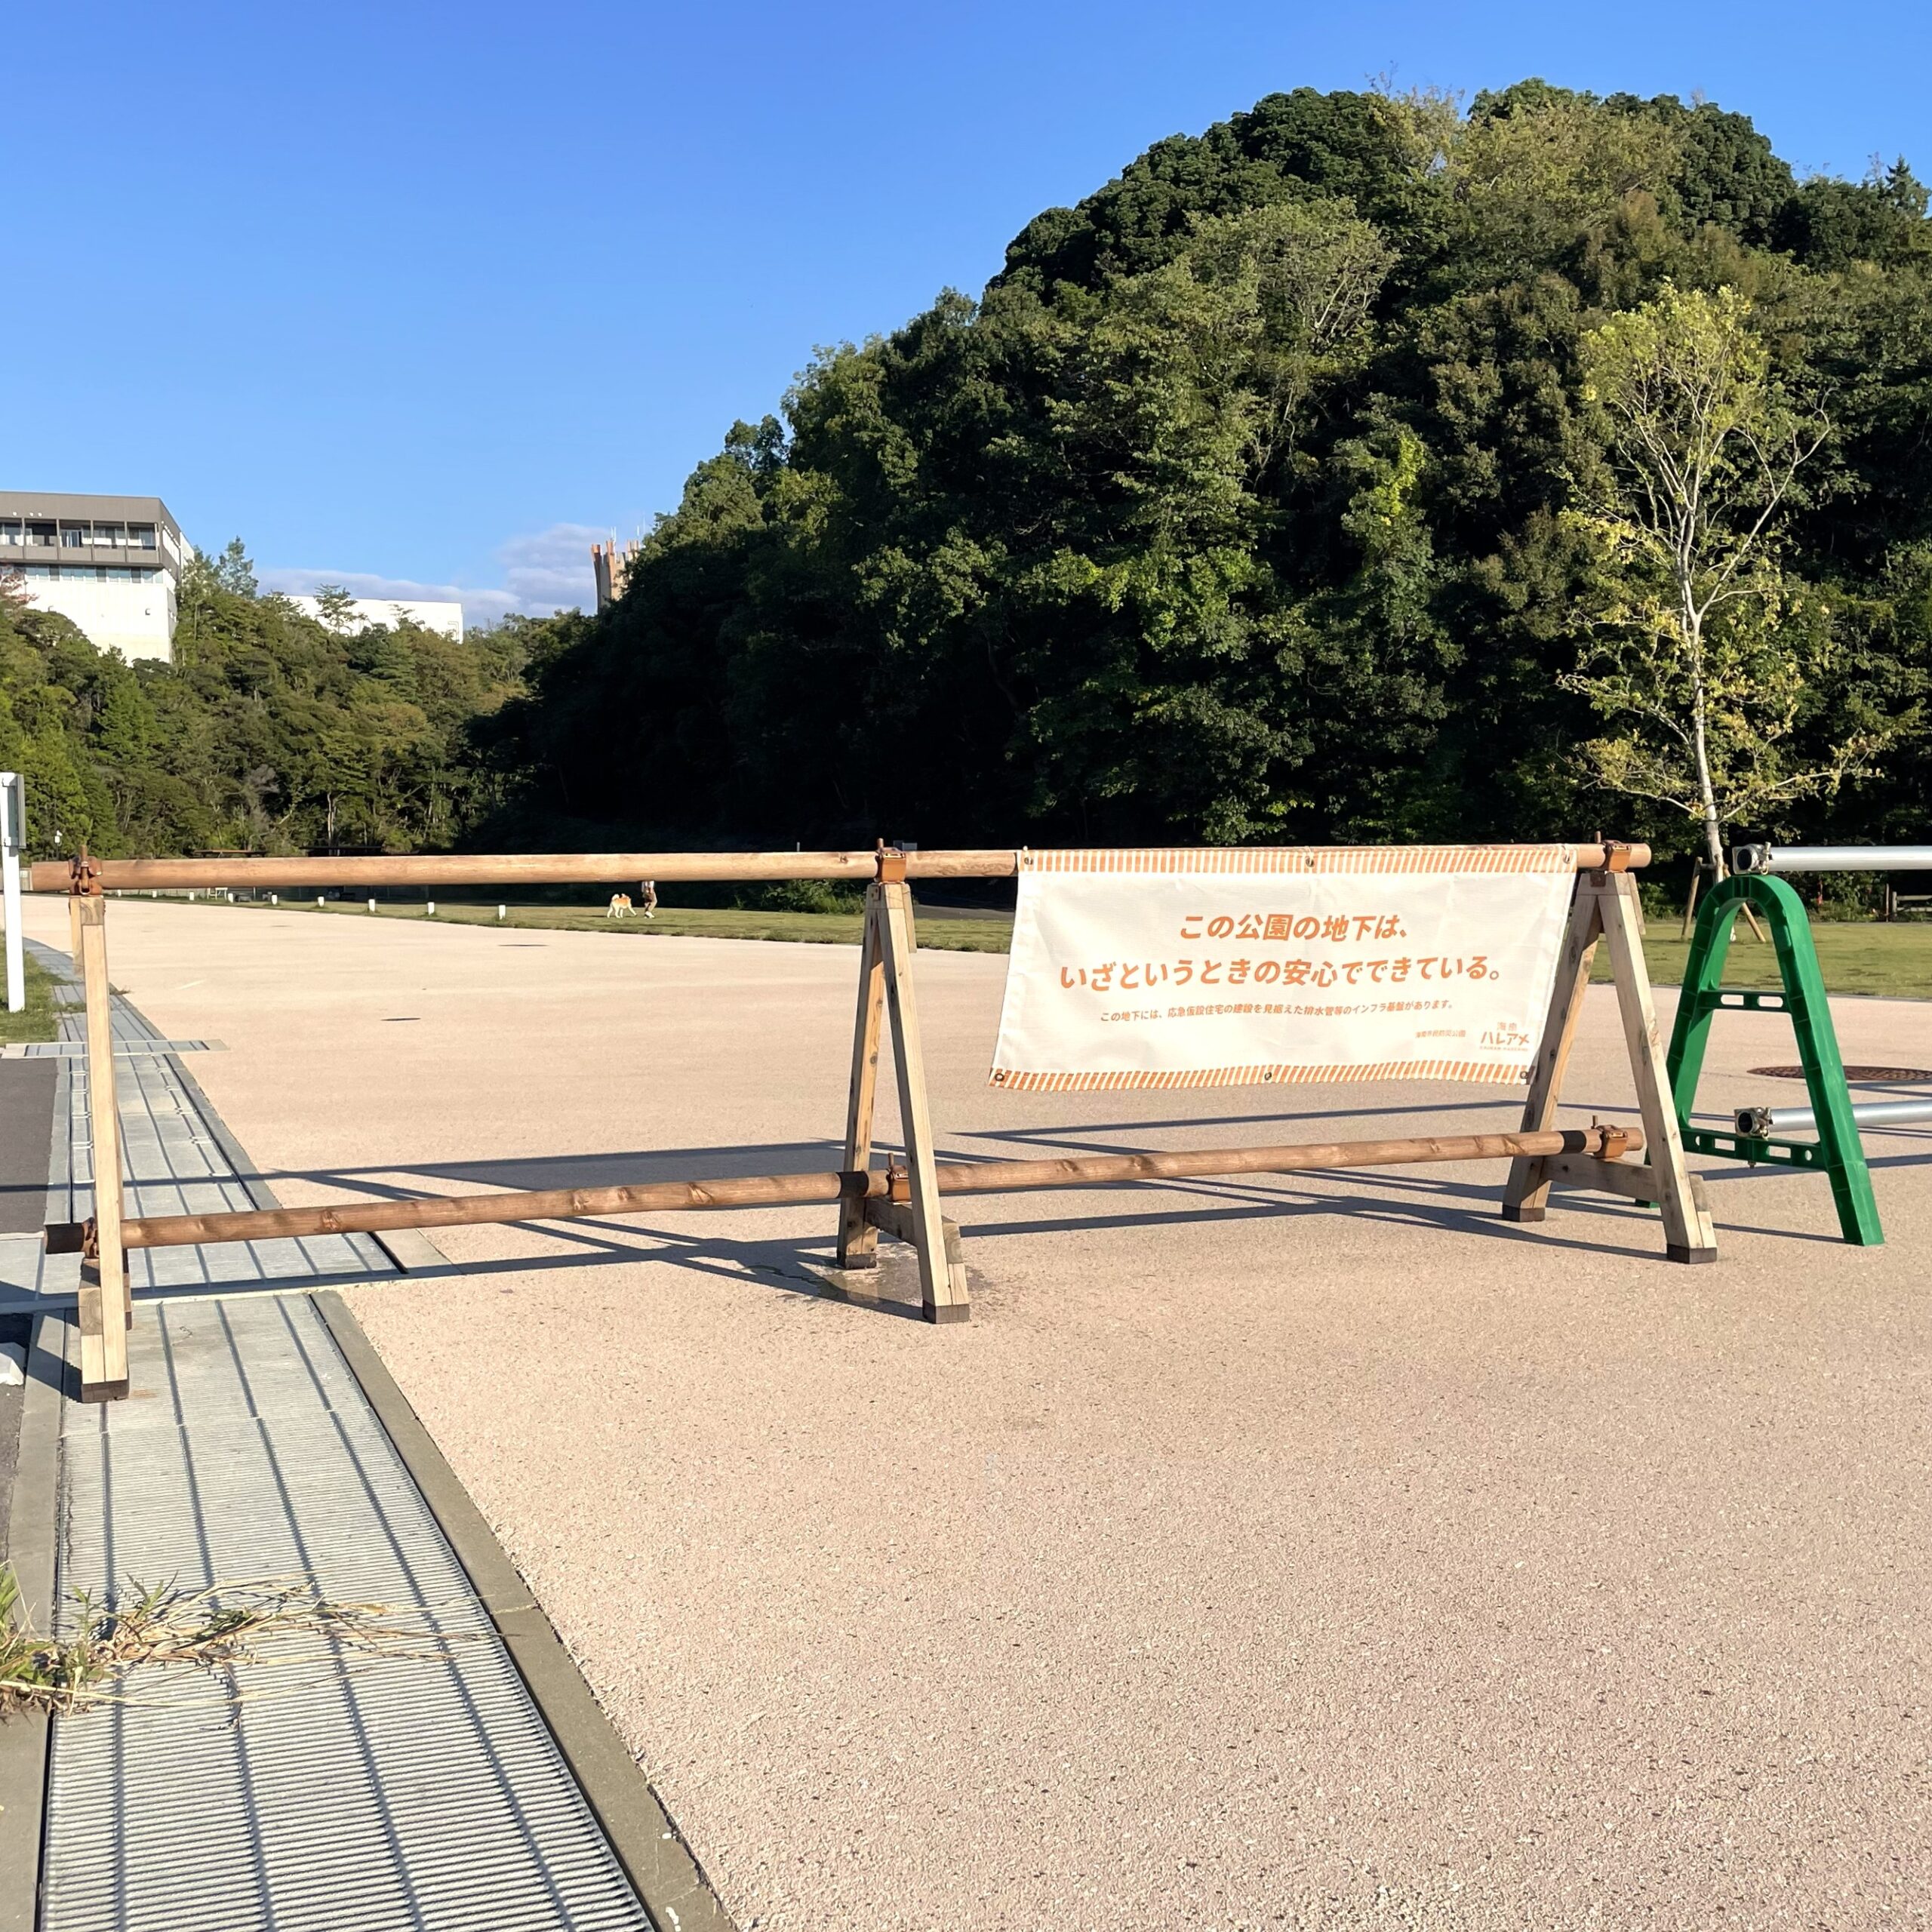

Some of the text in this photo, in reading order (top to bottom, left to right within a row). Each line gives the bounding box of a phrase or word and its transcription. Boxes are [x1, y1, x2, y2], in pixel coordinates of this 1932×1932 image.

[1180, 913, 1409, 942] この公園の地下は、
[1060, 955, 1500, 992] いざというときの安心でできている。
[1480, 1031, 1530, 1047] ハレアメ
